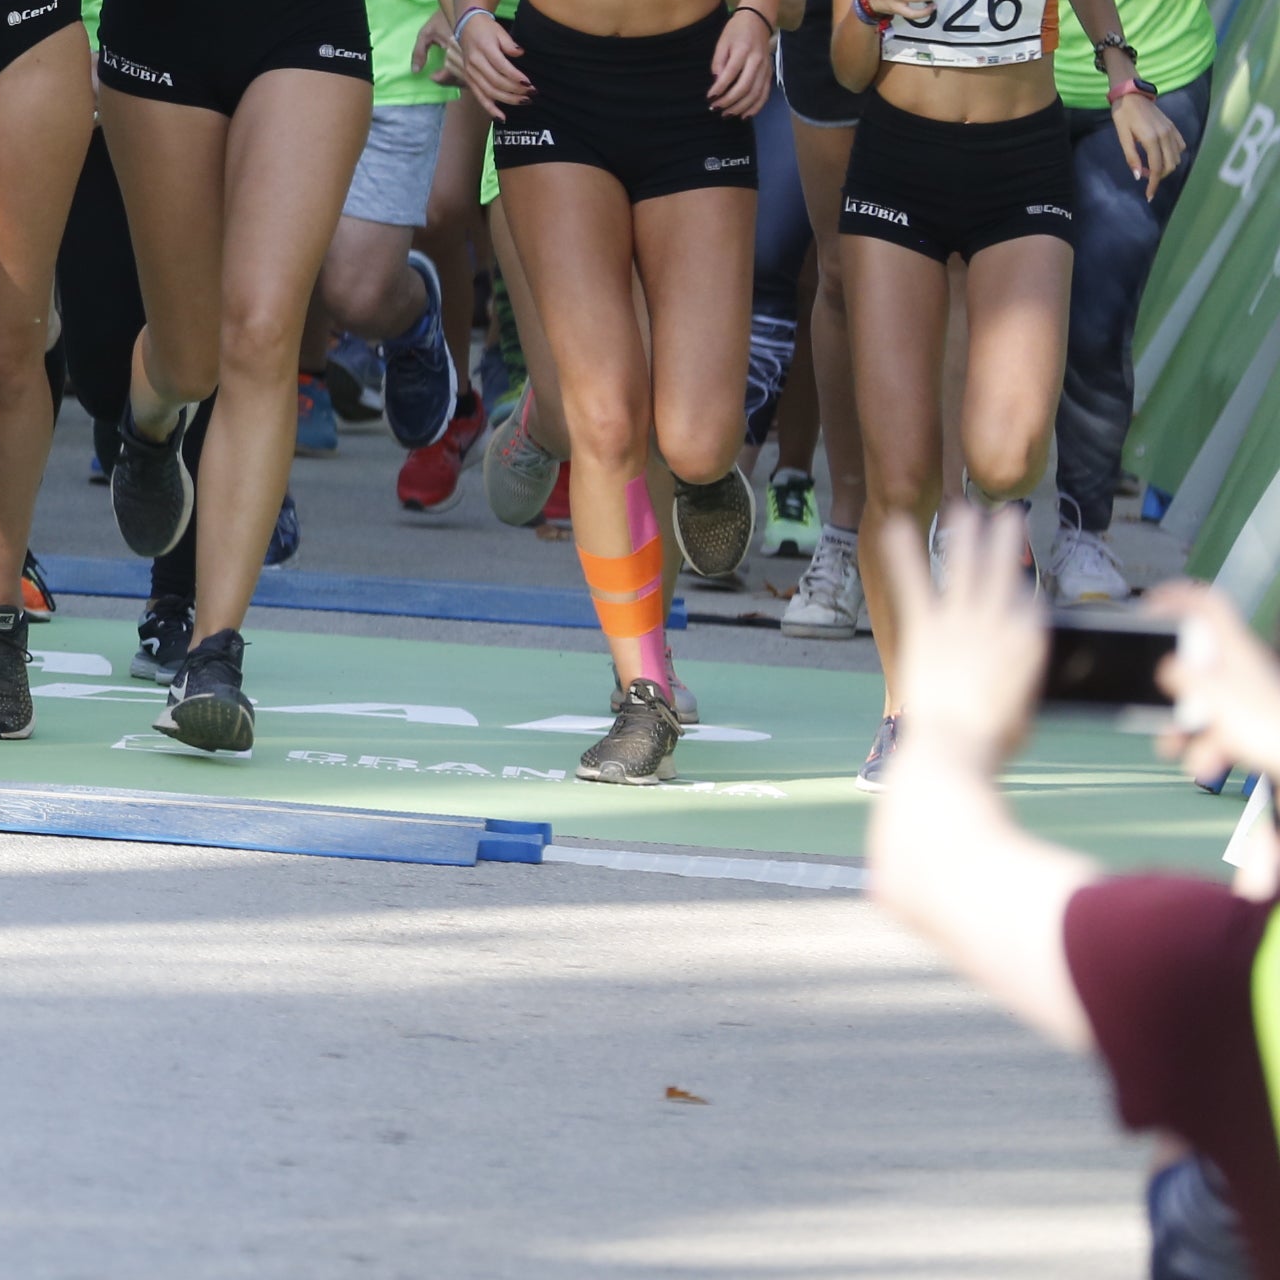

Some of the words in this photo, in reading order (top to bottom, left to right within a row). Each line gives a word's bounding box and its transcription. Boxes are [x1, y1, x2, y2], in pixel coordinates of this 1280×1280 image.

[22, 0, 58, 20] Cervi
[121, 62, 173, 86] ZUBIA
[504, 129, 555, 145] ZUBIA
[859, 204, 910, 226] ZUBIA
